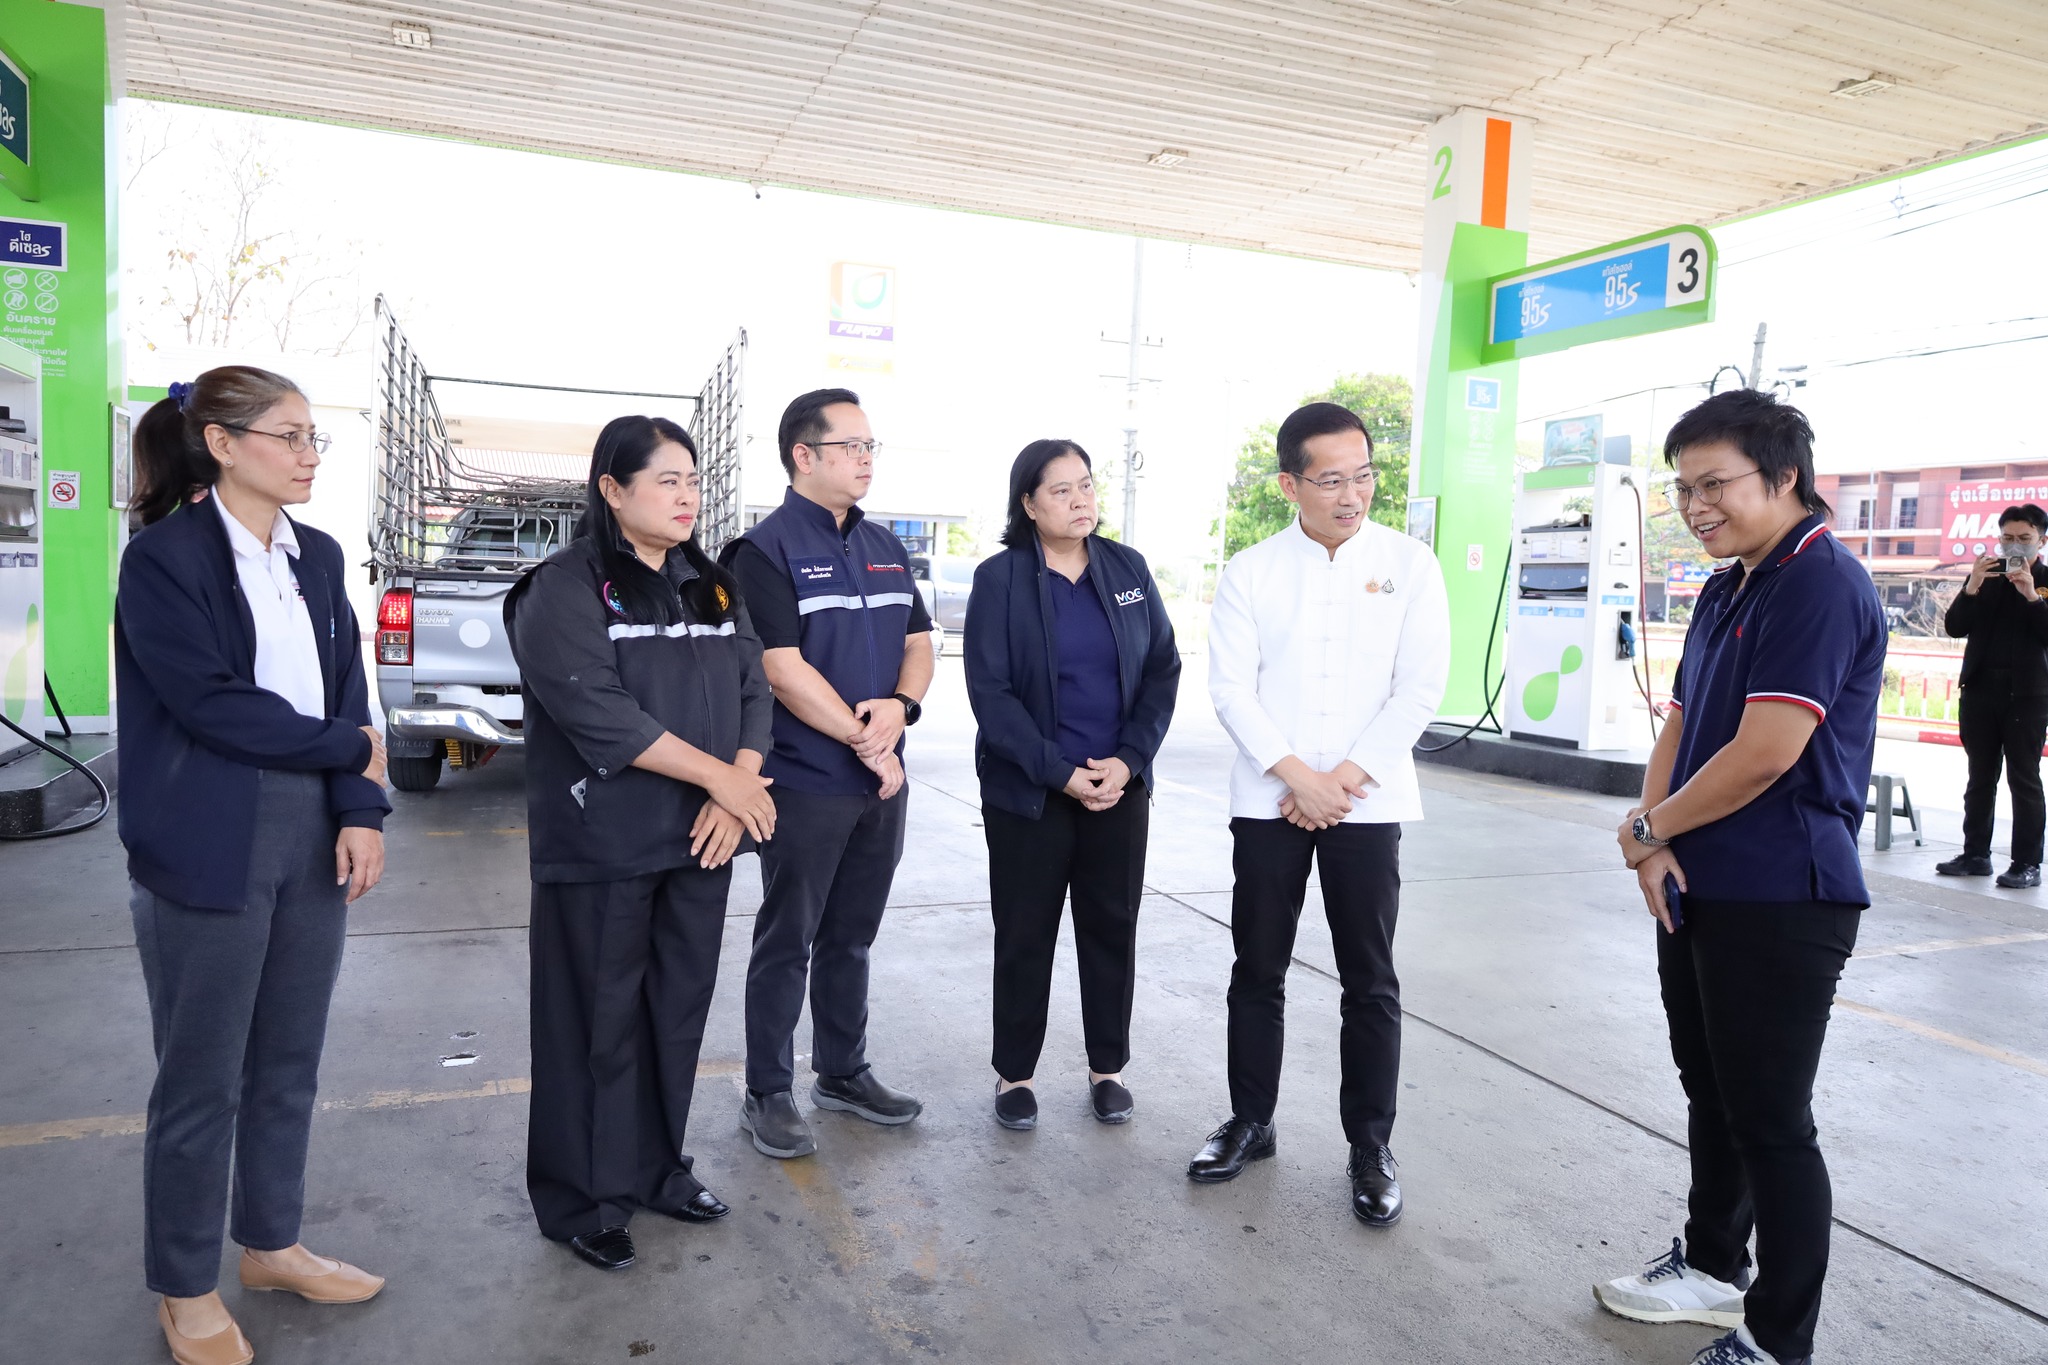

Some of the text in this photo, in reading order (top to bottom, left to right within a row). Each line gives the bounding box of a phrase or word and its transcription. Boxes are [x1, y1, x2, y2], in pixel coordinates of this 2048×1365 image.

[1432, 145, 1453, 200] 2
[1677, 248, 1699, 294] 3
[6, 311, 57, 326] อันตราย
[1588, 470, 1595, 482] 6
[1114, 587, 1144, 605] MOC
[418, 608, 454, 616] TOYOTA
